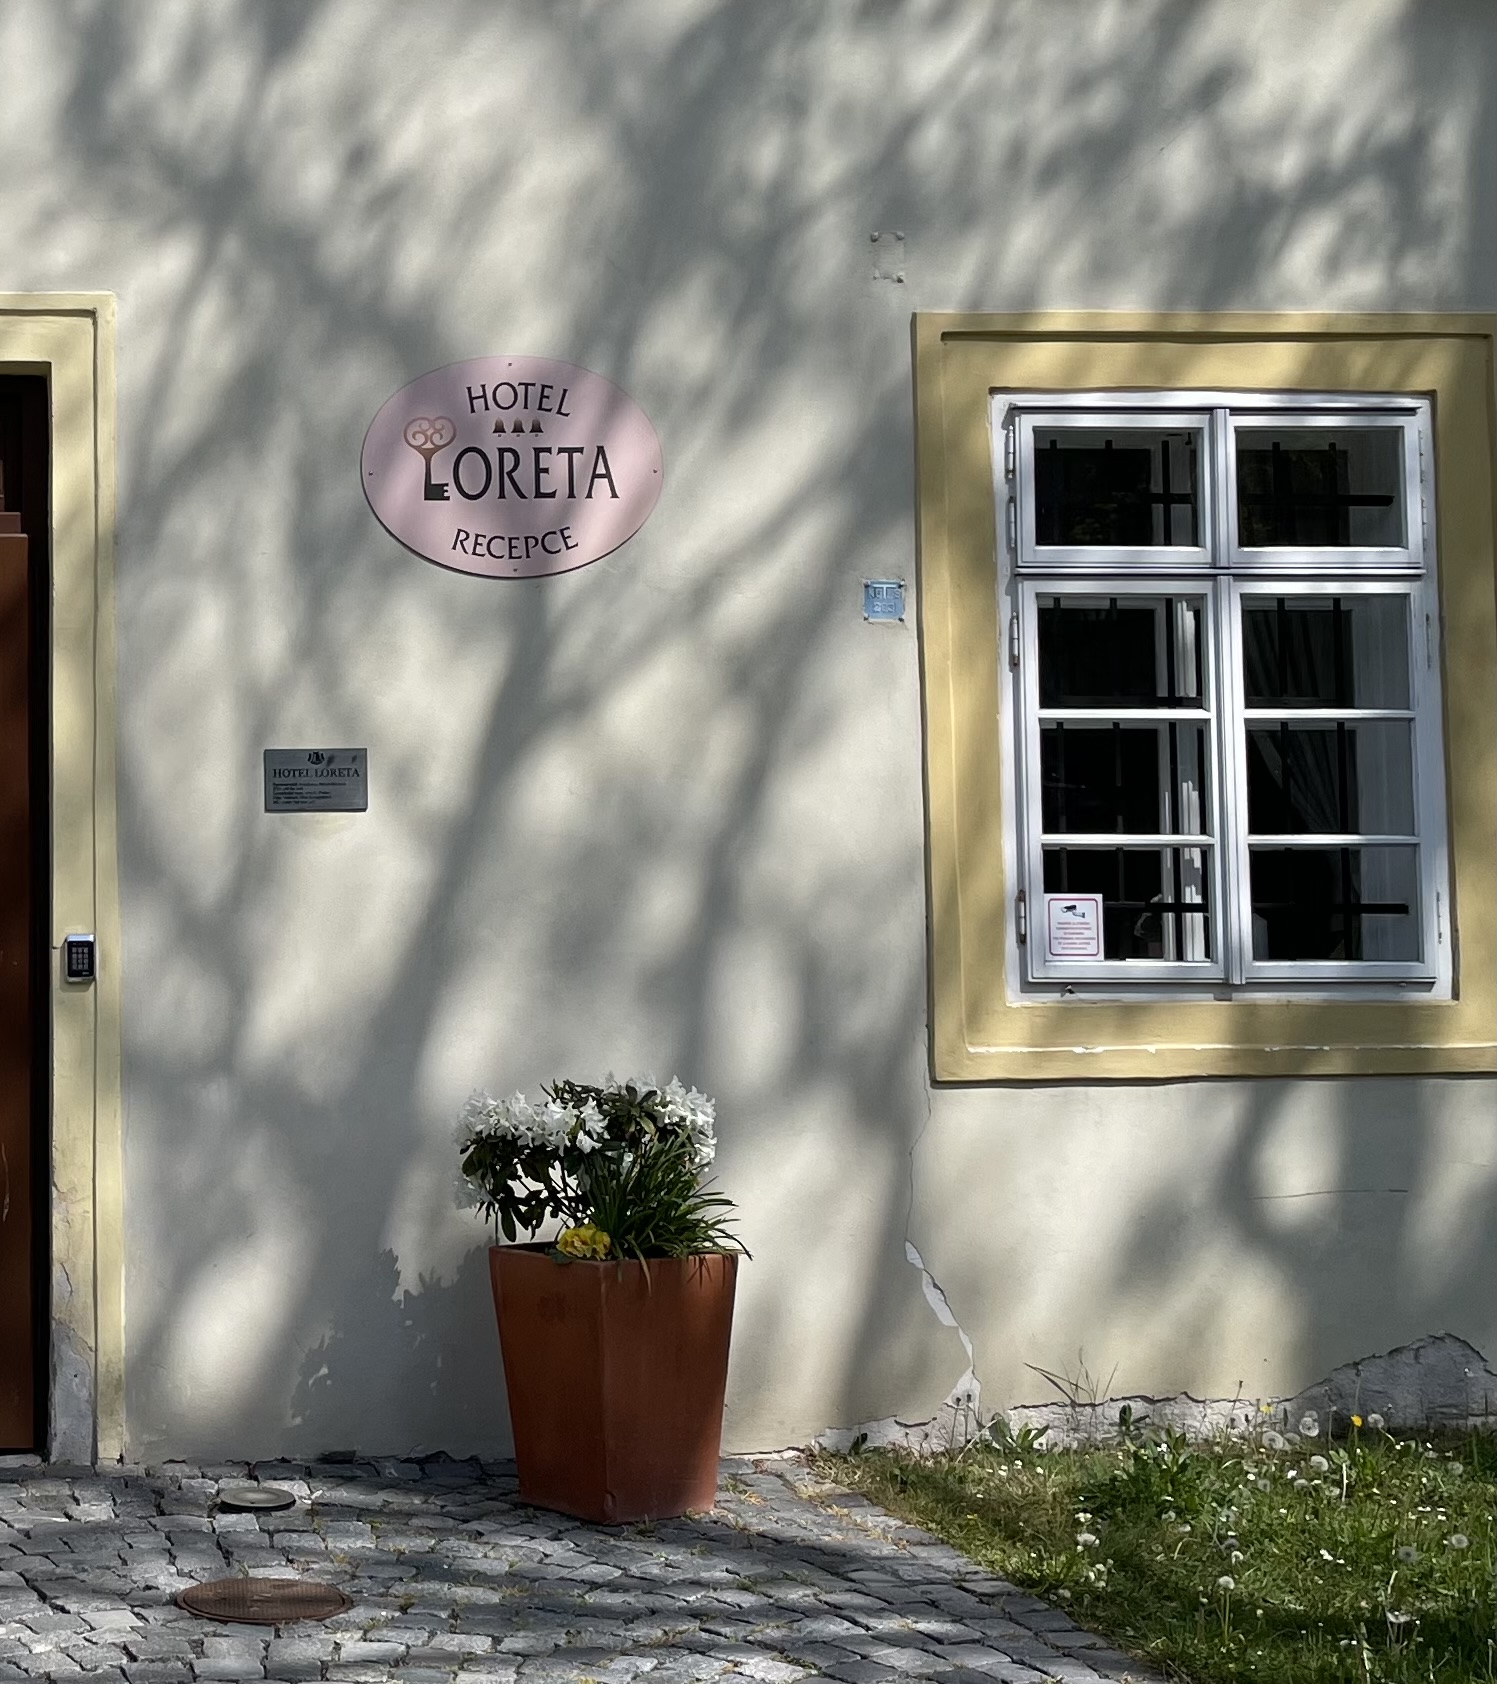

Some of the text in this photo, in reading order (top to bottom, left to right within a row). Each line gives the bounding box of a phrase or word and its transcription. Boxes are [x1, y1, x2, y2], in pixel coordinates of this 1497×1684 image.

[465, 381, 571, 417] HOTEL
[422, 445, 620, 501] LORETA
[451, 526, 579, 560] RECEPCE
[272, 767, 361, 779] HOTEL LORETA
